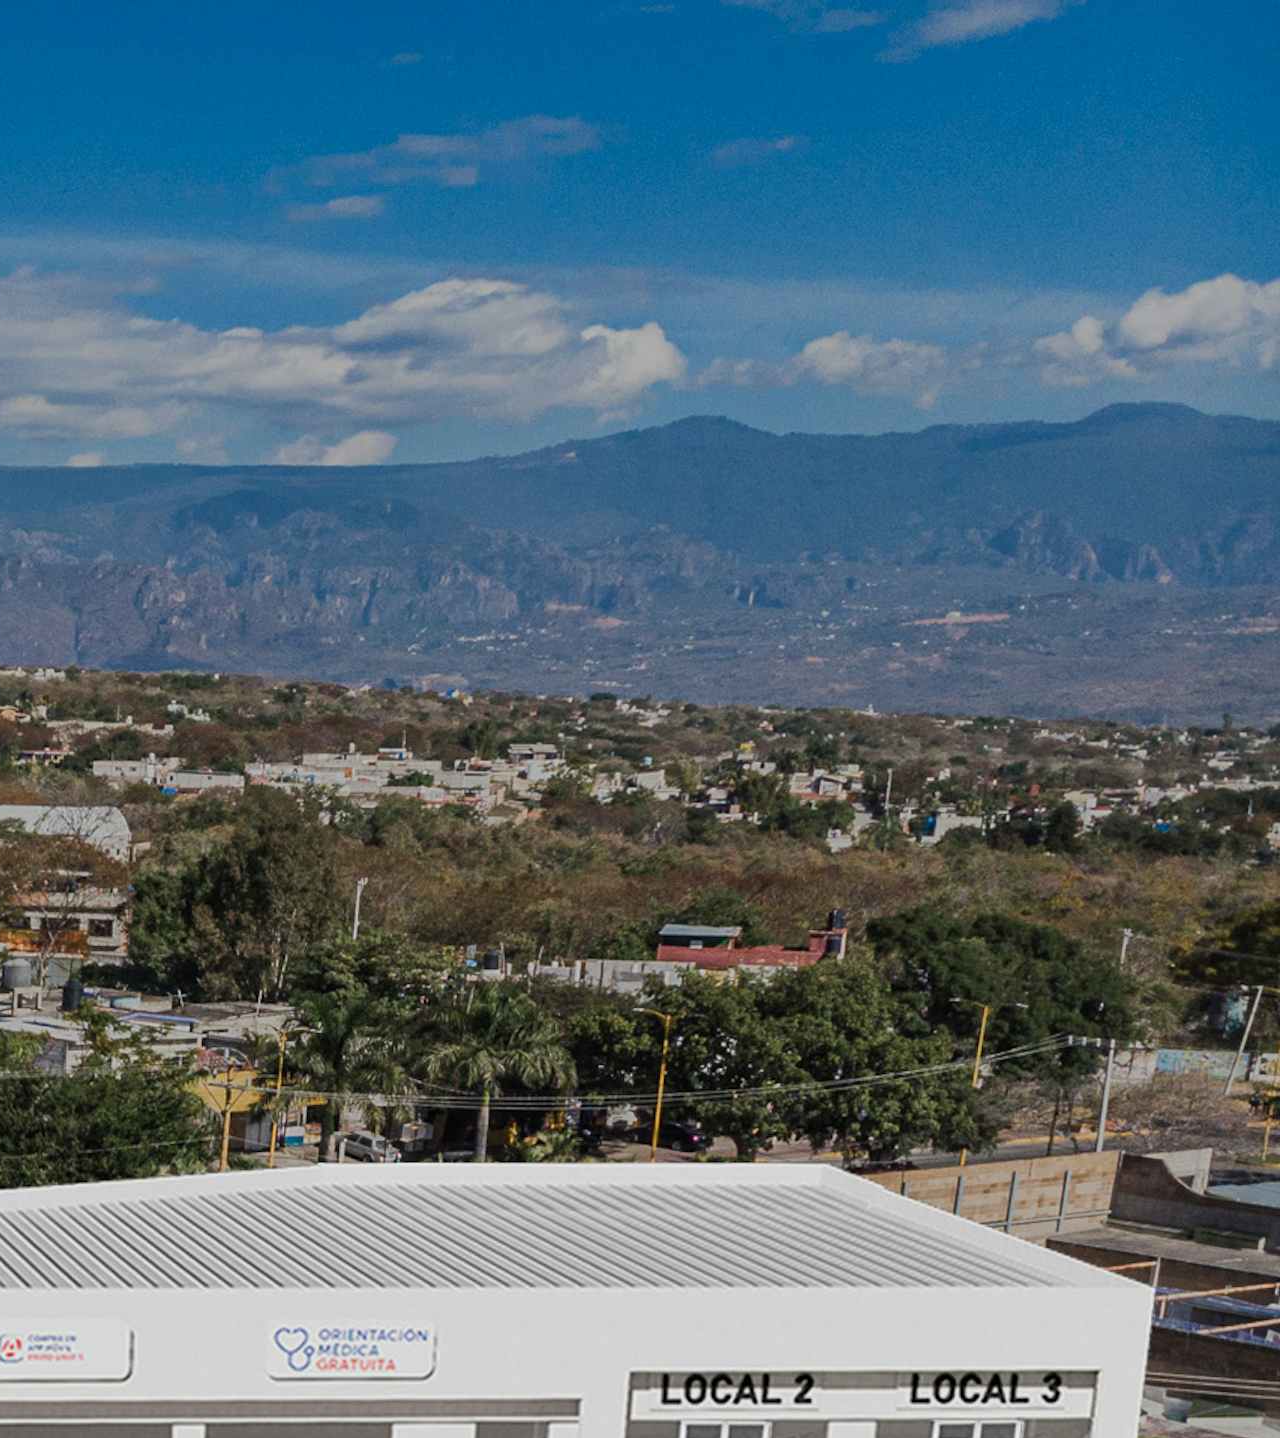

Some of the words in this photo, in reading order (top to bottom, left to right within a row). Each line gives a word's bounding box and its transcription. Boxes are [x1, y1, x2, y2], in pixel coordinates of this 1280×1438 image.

[318, 1326, 429, 1342] ORIENTACIÓN
[315, 1357, 397, 1371] GRATUITA
[661, 1373, 782, 1405] LOCAL
[794, 1373, 815, 1405] 2
[910, 1373, 1030, 1404] LOCAL
[1041, 1372, 1063, 1404] 3
